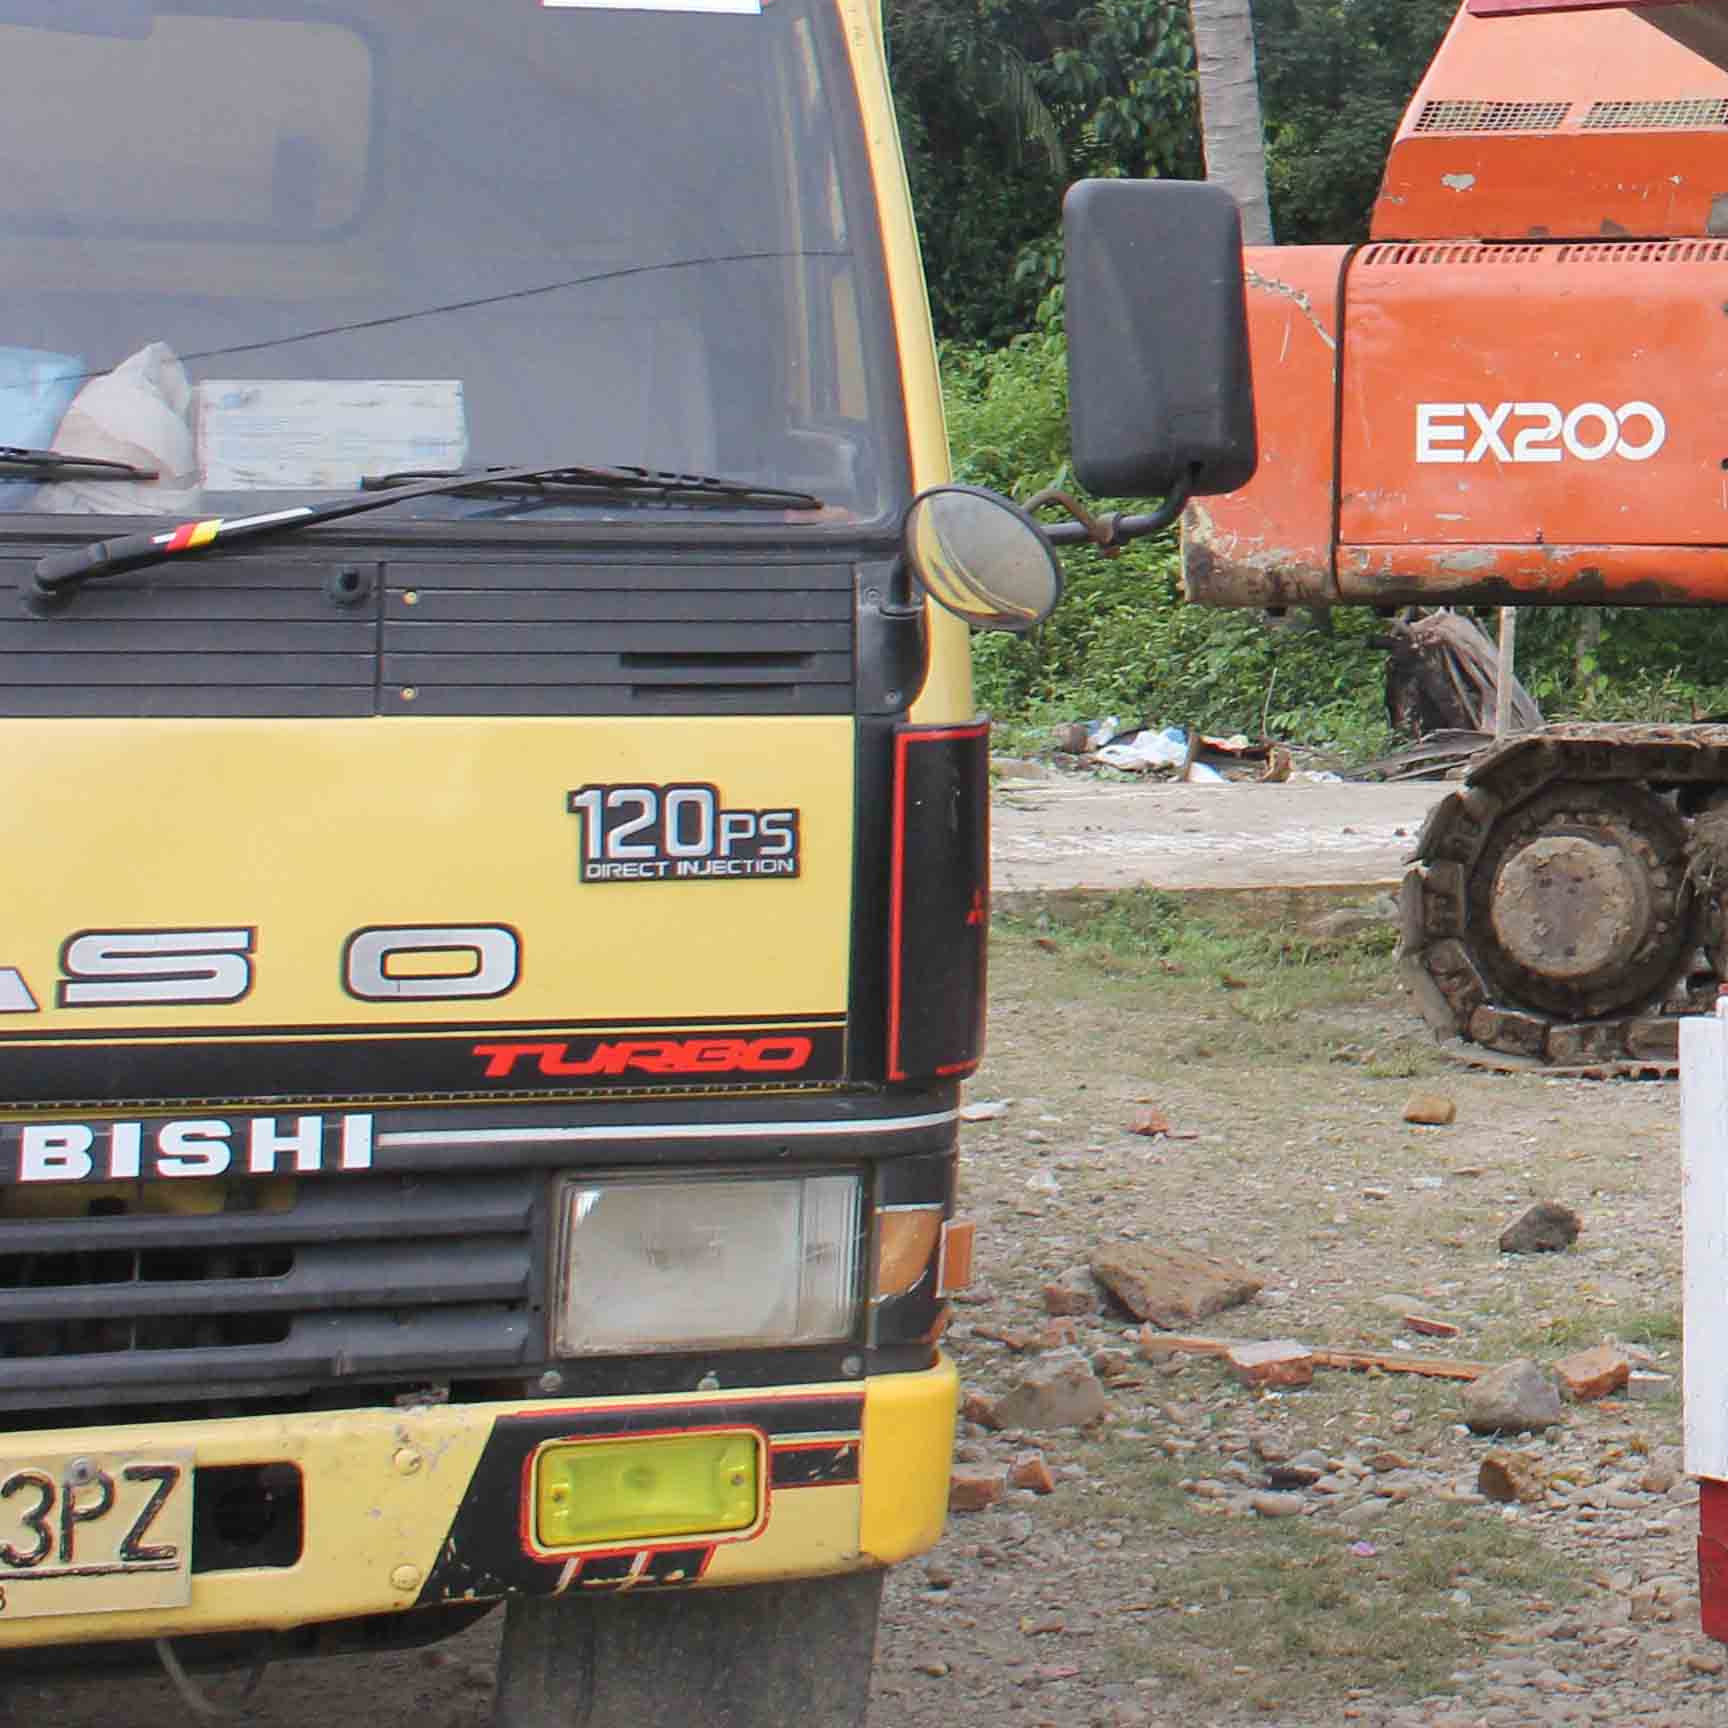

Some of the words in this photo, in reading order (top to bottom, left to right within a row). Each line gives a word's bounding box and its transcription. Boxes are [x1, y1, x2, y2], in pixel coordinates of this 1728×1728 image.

[1414, 401, 1666, 464] EX200
[585, 860, 672, 879] DIRECT
[676, 857, 794, 877] INJECTION
[0, 922, 523, 1013] SO
[472, 1036, 813, 1078] TURBO
[19, 1113, 375, 1183] BISHI
